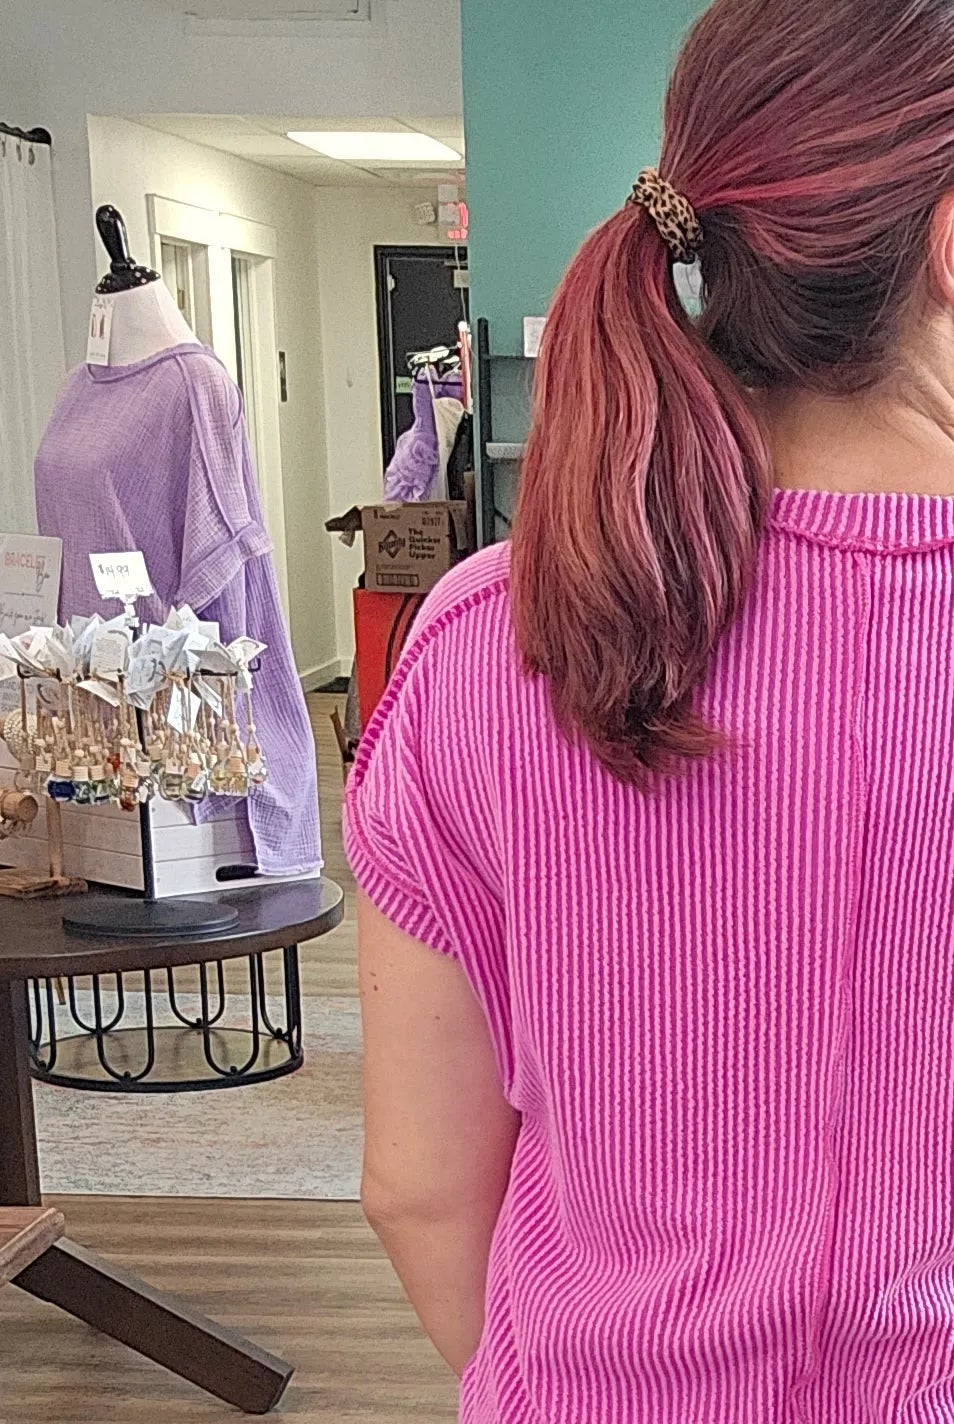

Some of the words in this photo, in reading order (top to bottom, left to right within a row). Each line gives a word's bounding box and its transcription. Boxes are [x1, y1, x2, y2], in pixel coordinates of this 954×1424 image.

[408, 528, 424, 536] The
[409, 536, 441, 544] Quicker
[409, 551, 436, 560] Upper
